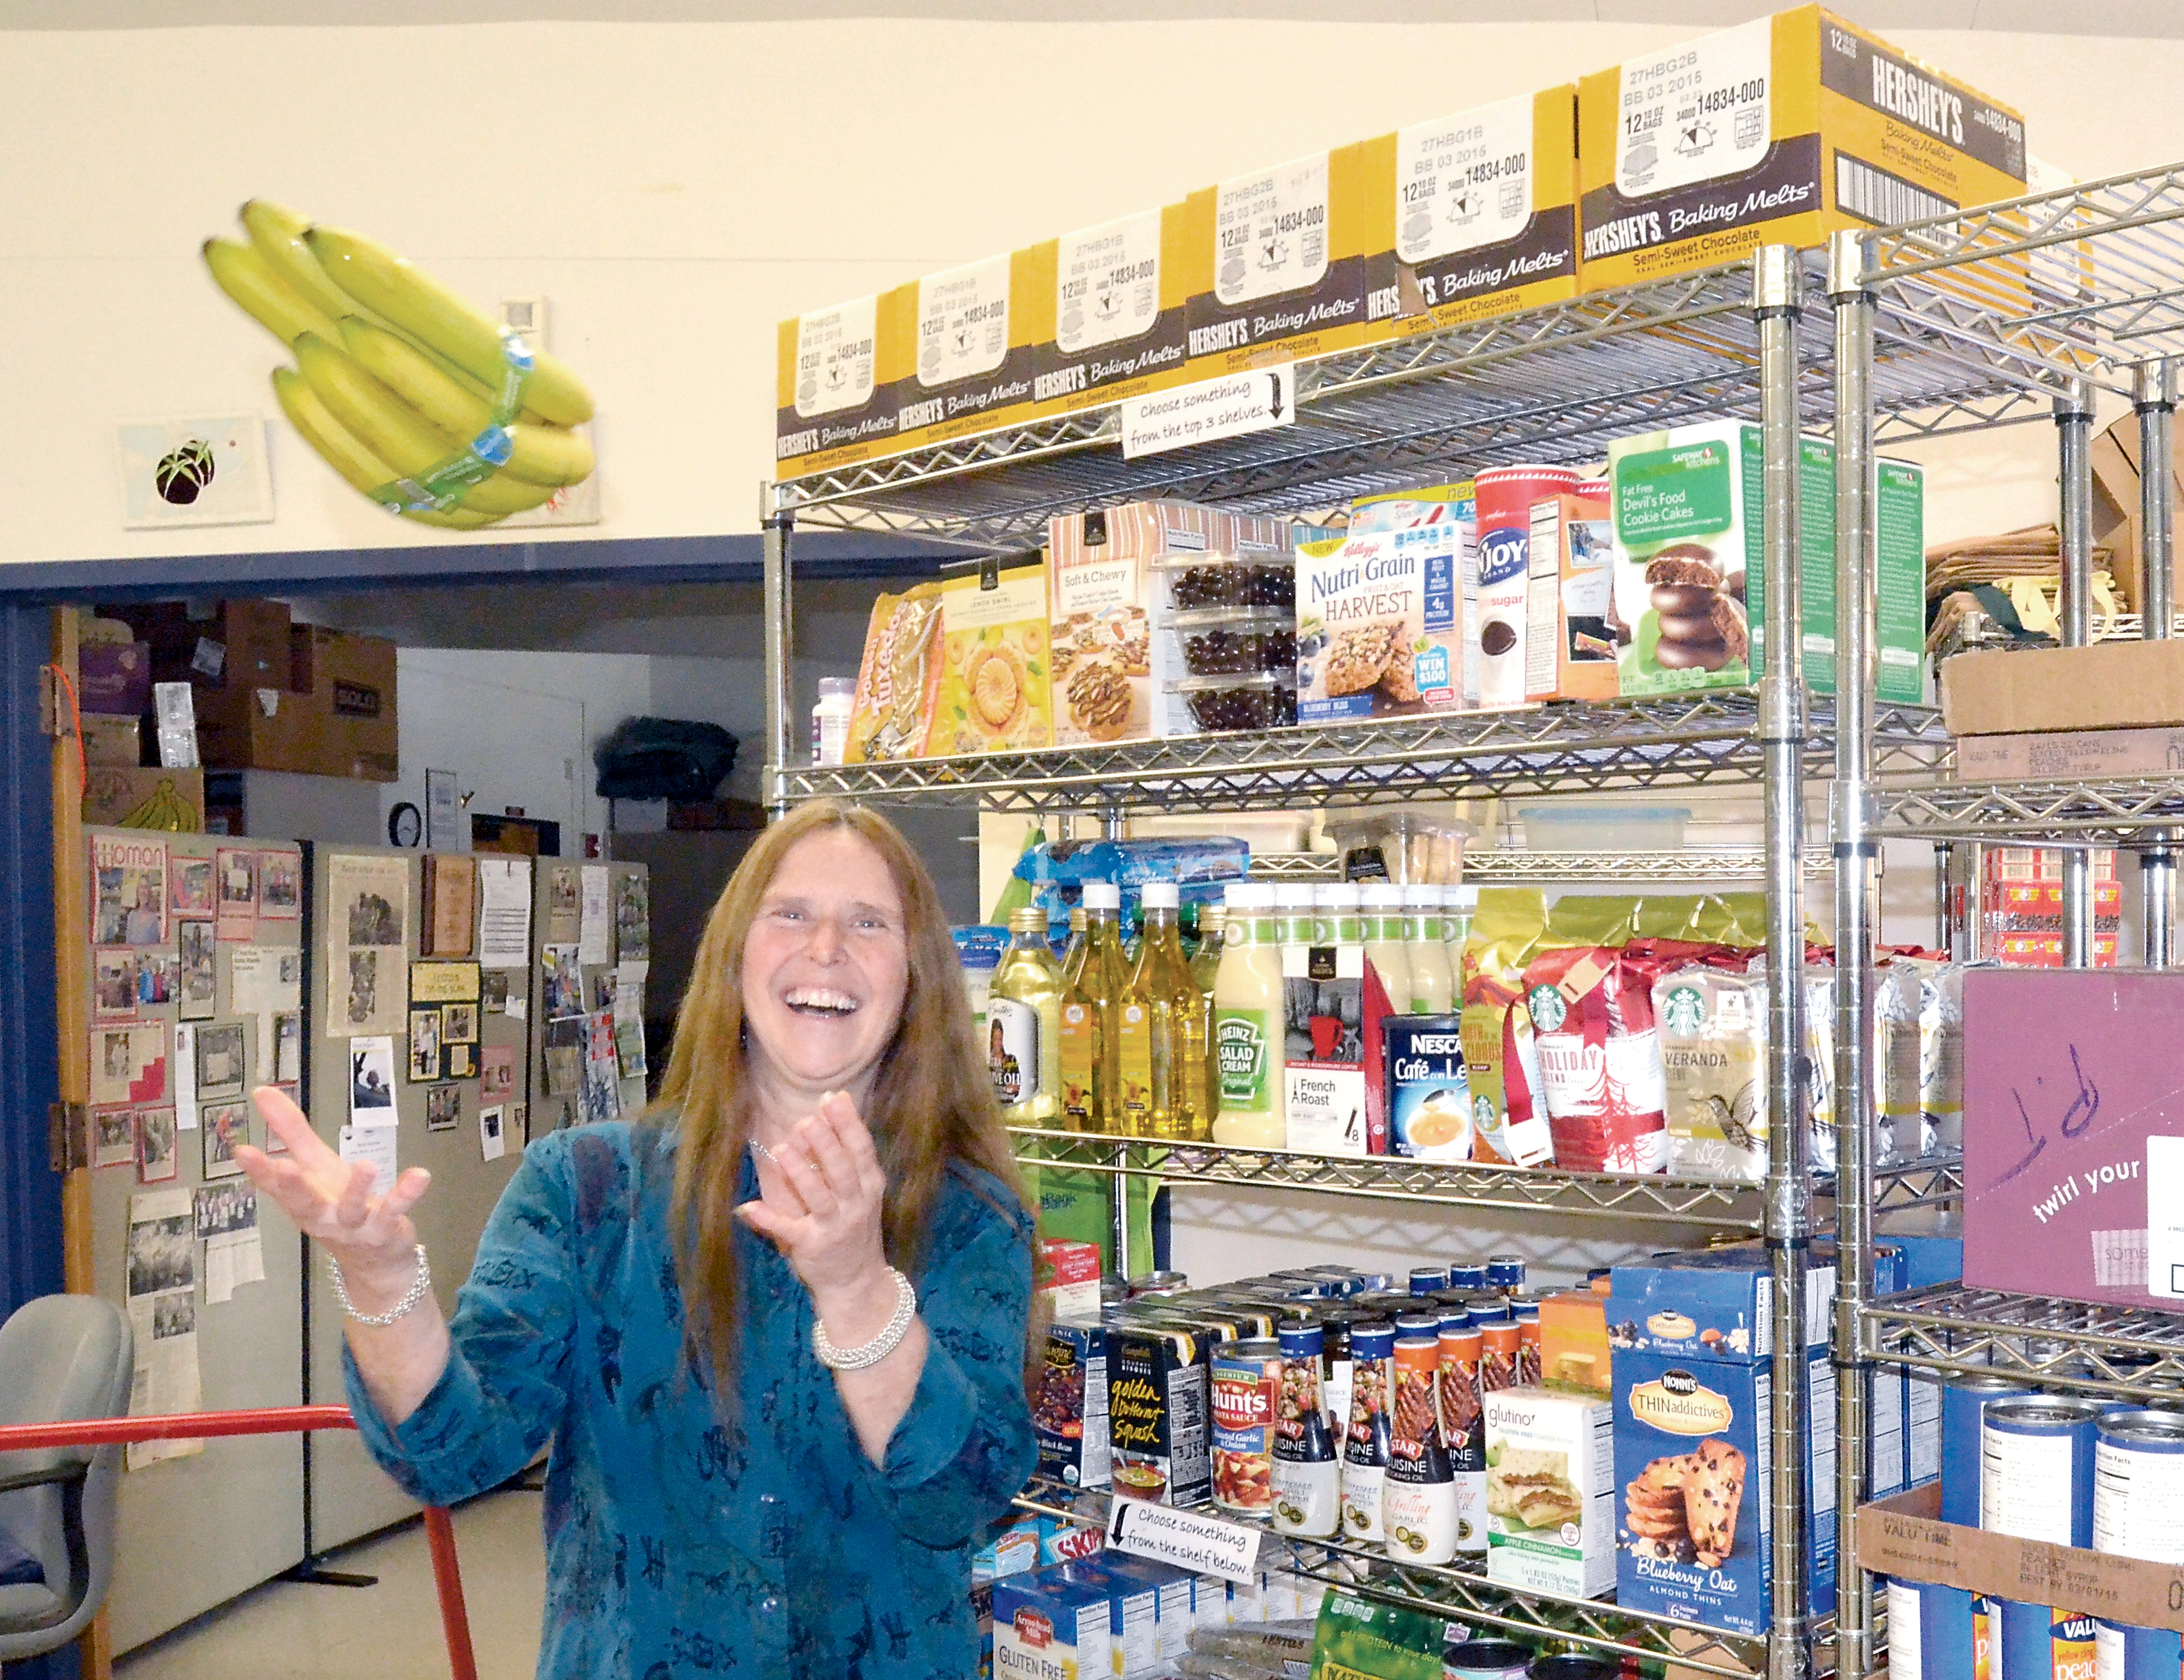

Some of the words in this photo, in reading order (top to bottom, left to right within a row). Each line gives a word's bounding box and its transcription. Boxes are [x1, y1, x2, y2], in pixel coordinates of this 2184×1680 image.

[1831, 29, 1842, 52] 12
[1630, 52, 1698, 84] 27HBG2B
[1624, 93, 1644, 107] BB
[1648, 87, 1663, 100] 03
[1669, 71, 1702, 94] 2015
[1626, 114, 1642, 135] 12
[1697, 78, 1764, 115] 14834-000
[1873, 55, 1964, 145] HERSHEY'S
[1422, 125, 1483, 153] 27HBG1B
[1886, 120, 1920, 150] Baking
[1415, 159, 1433, 174] BB
[1438, 154, 1452, 168] 03
[1456, 145, 1486, 164] 2015
[1403, 183, 1417, 202] 12
[1466, 153, 1525, 185] 14834-000
[1224, 180, 1273, 207] 27HBG2B
[1220, 211, 1235, 225] BB
[1221, 230, 1233, 248] 12
[1274, 205, 1324, 235] 14834-000
[1585, 212, 1661, 258] HERSHEY'S
[1669, 204, 1738, 234] Baking
[1739, 184, 1810, 216] Melts
[1633, 240, 1698, 267] Semi-Sweet
[1701, 228, 1760, 250] Chocolate
[1062, 282, 1073, 299] 12
[1110, 259, 1155, 287] 14834-000
[1443, 269, 1502, 296] Baking
[1503, 252, 1564, 280] Melts
[1471, 293, 1520, 312] Chocolate
[922, 322, 933, 335] 12
[1189, 318, 1248, 356] HERSHEY'S
[1254, 312, 1303, 337] Baking
[1304, 299, 1356, 323] Melts
[1276, 336, 1319, 351] Chocolate
[801, 355, 810, 370] 12
[1034, 363, 1086, 400] HERSHEY'S
[1091, 357, 1134, 382] Baking
[1135, 345, 1181, 370] Melts
[1110, 381, 1148, 396] Chocolate
[1141, 400, 1180, 418] Choose
[1184, 380, 1251, 408] something
[899, 397, 943, 431] HERSHEY'S
[948, 394, 987, 413] Baking
[987, 382, 1028, 403] Melts
[777, 429, 818, 458] HERSHEY'S
[822, 426, 857, 445] Baking
[858, 416, 894, 435] Melts
[1131, 429, 1161, 451] from
[1163, 424, 1181, 438] the
[1184, 420, 1203, 437] top
[1206, 417, 1214, 429] 3
[1218, 405, 1267, 425] shelves.
[1672, 450, 1703, 462] SAFEWAY
[1686, 456, 1720, 468] kitchens
[1623, 486, 1634, 496] Fat
[1623, 496, 1657, 511] Devil's
[1660, 489, 1685, 505] Food
[1624, 512, 1659, 526] Cookie
[1661, 506, 1693, 520] Cakes
[1313, 543, 1332, 554] NEW
[1344, 542, 1379, 558] Kellogg's
[1065, 574, 1080, 587] Soft
[1083, 573, 1090, 584] &
[1091, 570, 1126, 582] Chewy
[1312, 564, 1359, 603] Nutri
[1366, 553, 1414, 580] Grain
[1326, 590, 1412, 620] HARVEST
[1492, 596, 1524, 607] sugar
[1419, 659, 1444, 670] WIN
[1420, 670, 1446, 683] $100
[1221, 1026, 1250, 1042] HEINZ
[1220, 1047, 1254, 1061] SALAD
[1540, 1050, 1597, 1071] HOLIDAY
[1665, 1052, 1728, 1067] VERANDA
[1222, 1061, 1251, 1072] CREAM
[1395, 1058, 1429, 1080] Café
[1301, 1079, 1335, 1092] French
[1301, 1093, 1329, 1106] Roast
[1353, 1129, 1359, 1141] 8
[2033, 1175, 2079, 1224] twirl
[2084, 1160, 2140, 1194] your
[1663, 1376, 1696, 1392] NONNI'S
[1111, 1378, 1160, 1416] golden
[1637, 1395, 1724, 1419] THINaddictives
[1489, 1403, 1530, 1427] glutino
[1042, 1440, 1056, 1448] Black
[1058, 1442, 1072, 1452] Bean
[1225, 1440, 1246, 1449] Onion
[1235, 1434, 1259, 1443] Garlic
[1391, 1440, 1416, 1455] STAR
[2115, 1456, 2131, 1465] Facts
[1392, 1515, 1427, 1524] GARLIC
[1139, 1510, 1177, 1529] Choose
[1179, 1523, 1246, 1552] something
[1128, 1531, 1155, 1549] from
[1160, 1542, 1176, 1556] the
[1181, 1548, 1211, 1569] shelf
[1214, 1554, 1249, 1575] below.
[1524, 1542, 1561, 1555] CINNAMON
[1637, 1557, 1704, 1592] Blueberry
[1710, 1571, 1736, 1591] Oat
[1650, 1585, 1688, 1598] ALMOND
[1693, 1595, 1722, 1605] THINS
[1671, 1604, 1679, 1617] 6
[999, 1646, 1039, 1674] GLUTEN
[1042, 1659, 1067, 1680] FREE
[2059, 1650, 2079, 1660] yellow
